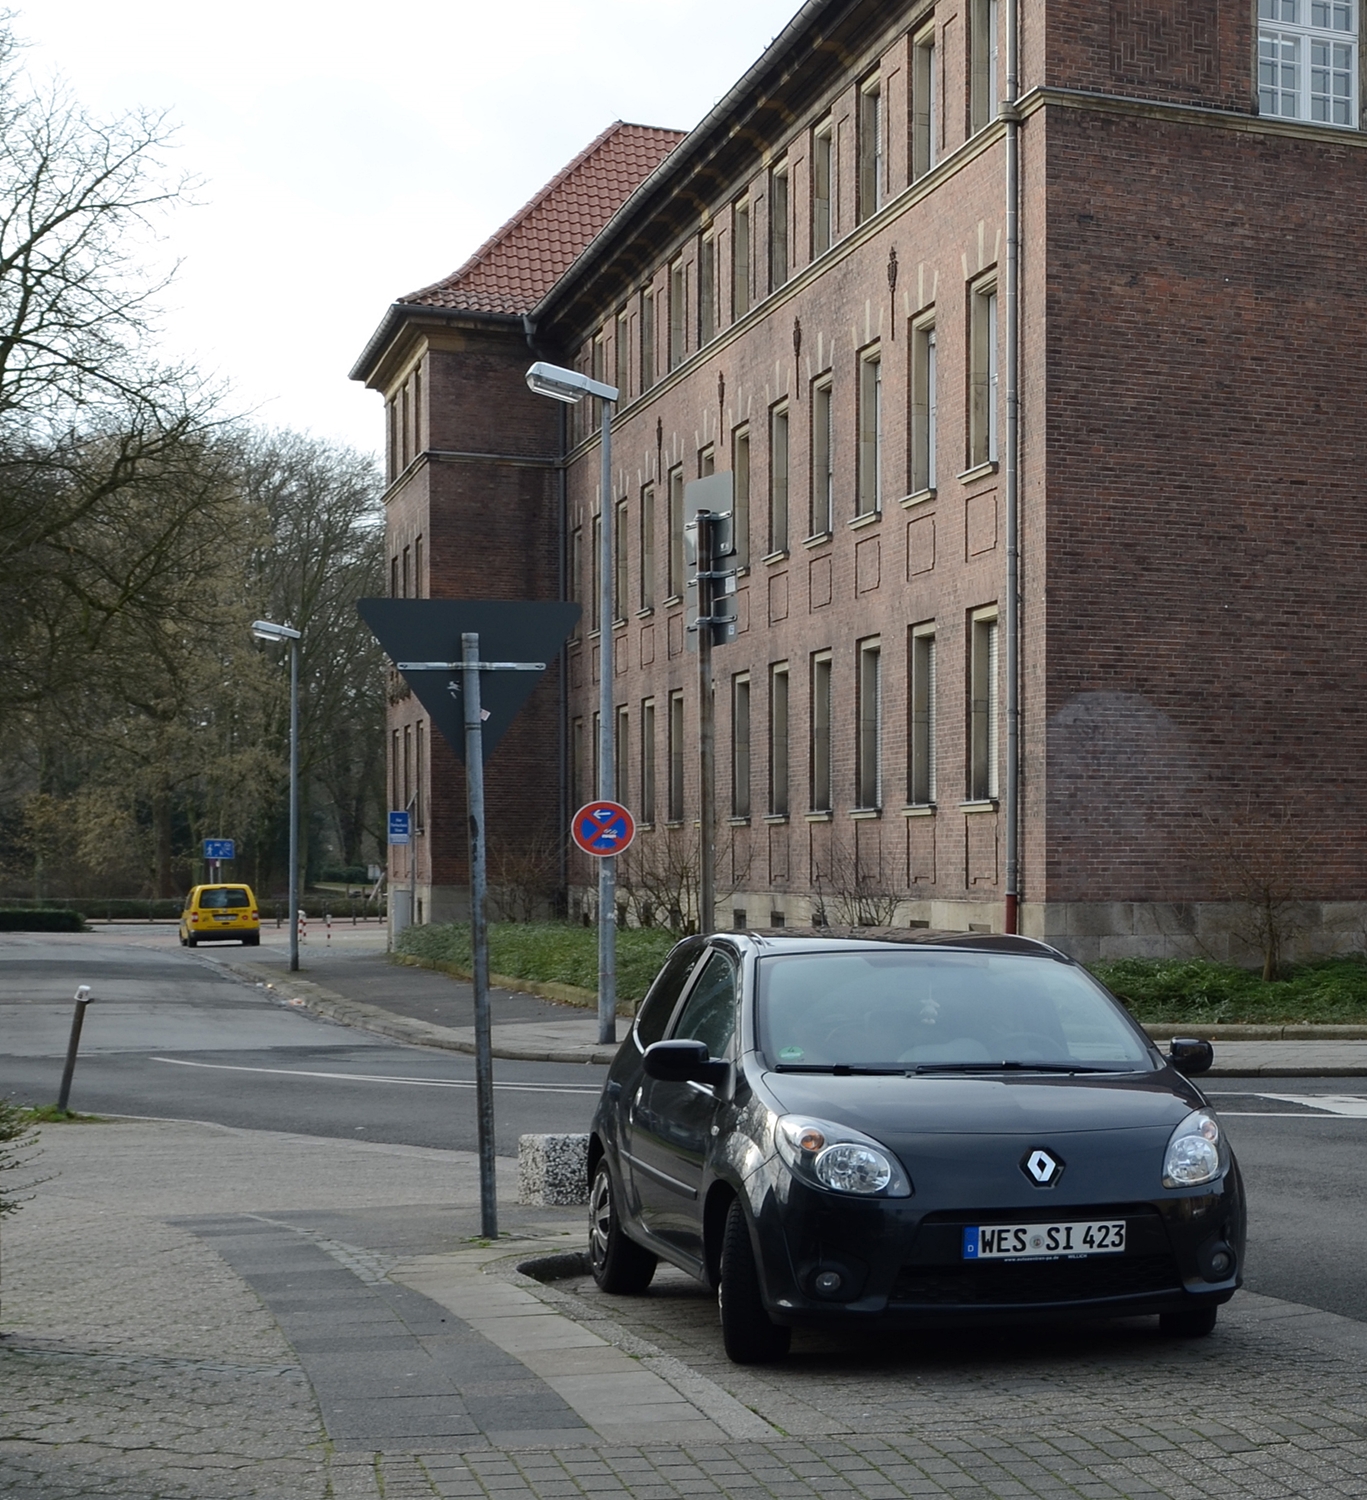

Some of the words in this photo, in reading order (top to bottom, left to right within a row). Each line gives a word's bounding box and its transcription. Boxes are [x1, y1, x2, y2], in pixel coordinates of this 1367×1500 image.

[981, 1228, 1027, 1253] WES
[1046, 1226, 1074, 1251] SI
[1082, 1224, 1125, 1249] 423
